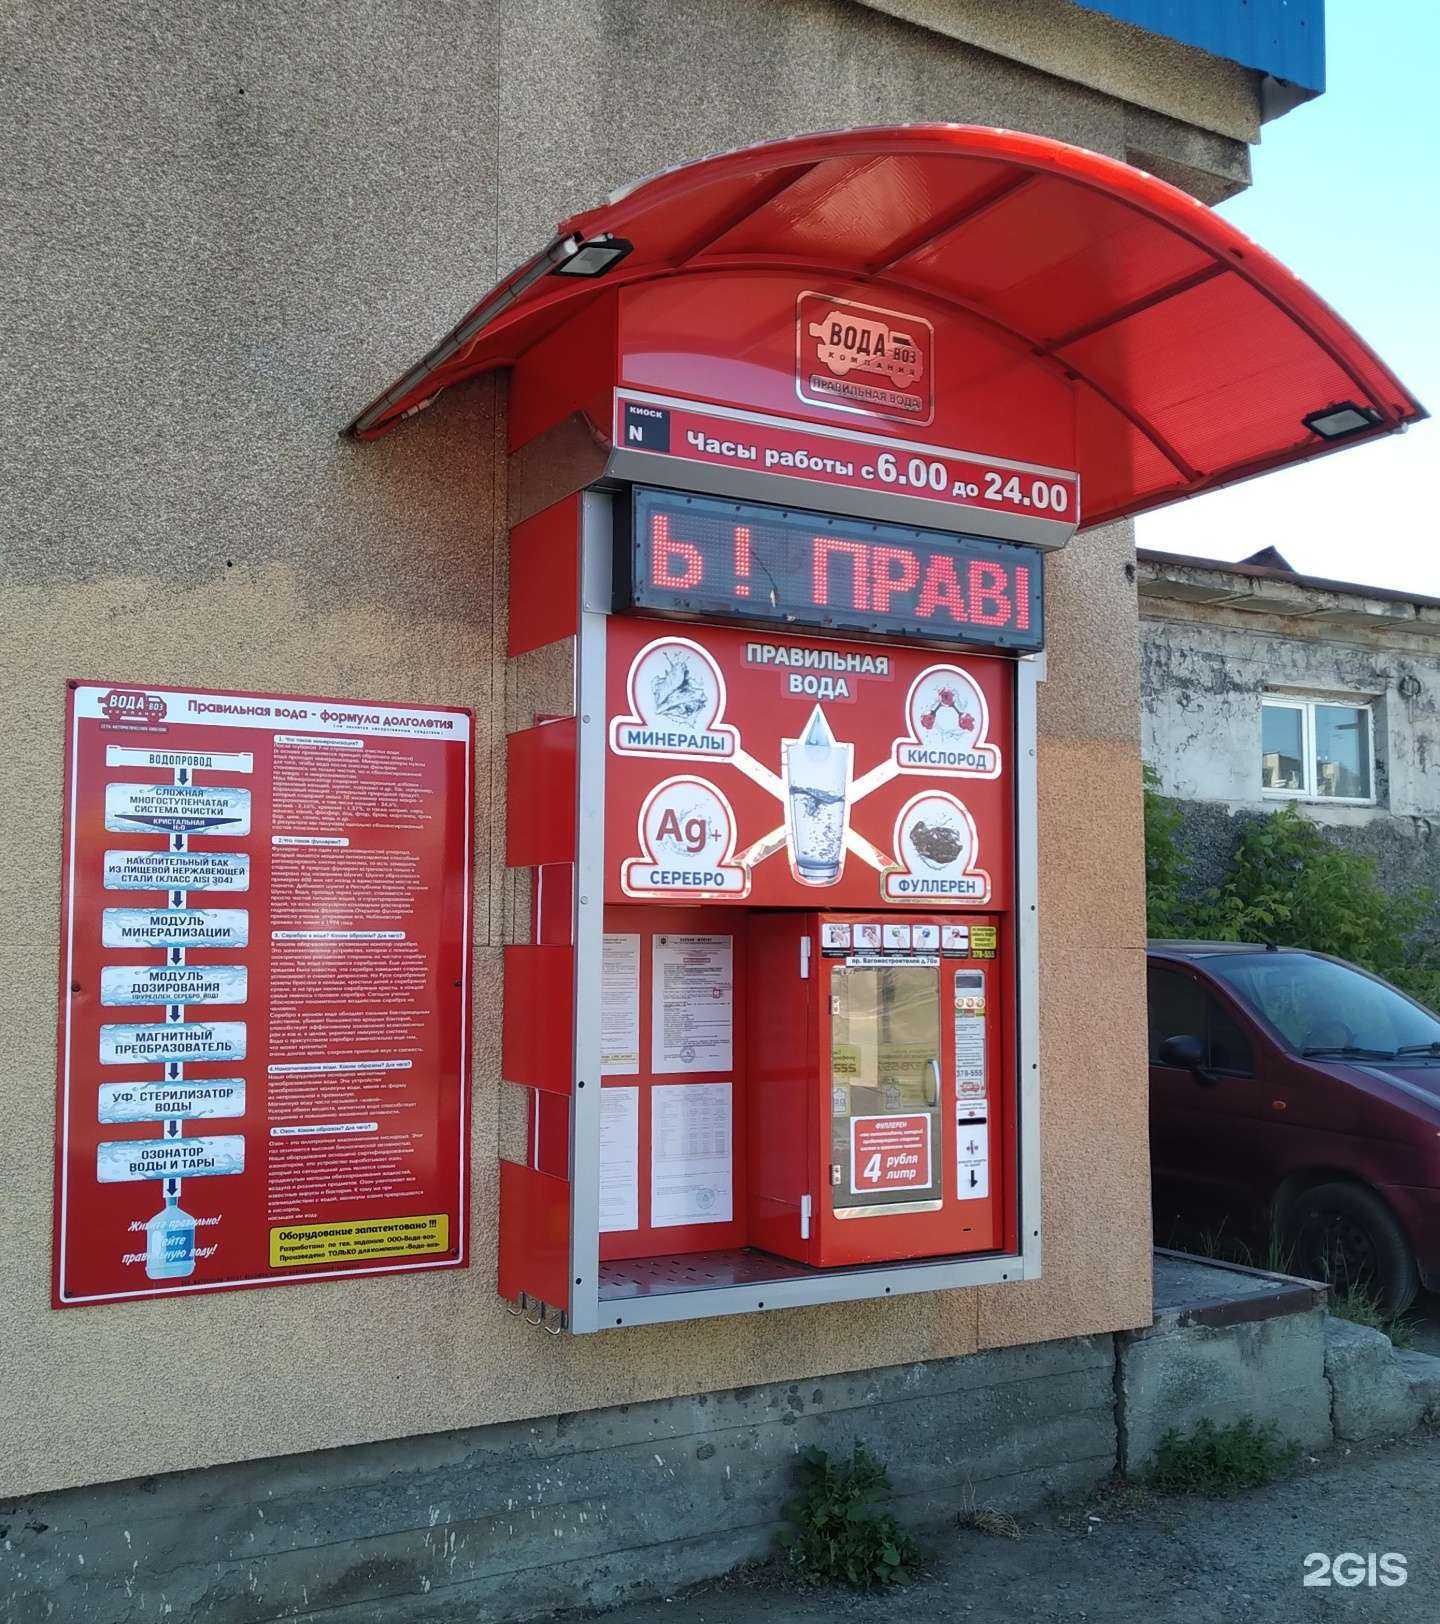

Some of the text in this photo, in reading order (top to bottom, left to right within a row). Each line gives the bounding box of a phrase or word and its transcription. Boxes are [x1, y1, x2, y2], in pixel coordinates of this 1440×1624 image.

[828, 352, 916, 376] КОМПАНИЯ
[812, 377, 921, 411] ПРАВИЛЬНАЯ ВОДА
[629, 424, 643, 442] N
[687, 430, 1068, 513] Часы работы с 6.00 до 24.00
[746, 643, 889, 675] ПРАВИЛЬНАЯ
[789, 674, 849, 699] ВОДА
[187, 699, 271, 716] Правильная
[274, 707, 308, 720] вода
[320, 710, 380, 725] формула
[382, 714, 454, 730] долголетия
[627, 730, 725, 751] МИНЕРАЛЫ
[149, 754, 213, 767] ВОДОПРОВОД
[907, 749, 987, 770] КИСЛОРОД
[155, 788, 204, 798] СЛОЖНАЯ
[129, 796, 229, 807] МНОГОСТУПЕНЧАТАЯ
[134, 805, 224, 816] СИСТЕМА ОЧИСТКИ
[126, 857, 229, 867] НАКОПИТЕЛЬНЫЙ БАК
[124, 865, 170, 875] ПИЩЕВОЙ
[172, 866, 245, 876] НЕРЖАВЕЮЩЕЙ
[155, 875, 190, 884] (КЛАСС
[193, 876, 210, 884] AISI
[650, 871, 725, 886] СЕРЕБРО
[898, 879, 976, 893] ФУЛЛЕРЕН
[150, 916, 204, 926] МОДУЛЬ
[121, 927, 231, 938] МИНЕРАЛИЗАЦИИ
[149, 971, 204, 982] МОДУЛЬ
[131, 982, 220, 994] ДОЗИРОВАНИЯ
[135, 1030, 213, 1042] МАГНИТНЫЙ
[115, 1042, 232, 1054] ПРЕОБРАЗОВАТЕЛЬ
[112, 1088, 234, 1103] УФ. СТЕРИЛИЗАТОР
[155, 1102, 192, 1113] ВОДЫ
[141, 1147, 204, 1160] ОЗОНАТОР
[129, 1158, 215, 1172] ВОДЫ И ТАРЫ
[886, 1153, 919, 1168] рубля
[863, 1153, 882, 1183] 4
[885, 1168, 917, 1181] литр
[279, 1228, 353, 1242] Оборудование
[355, 1222, 427, 1236] запатентовано
[189, 1243, 219, 1258] воду!
[279, 1252, 326, 1262] Произведено
[328, 1249, 356, 1257] ТОЛЬКО
